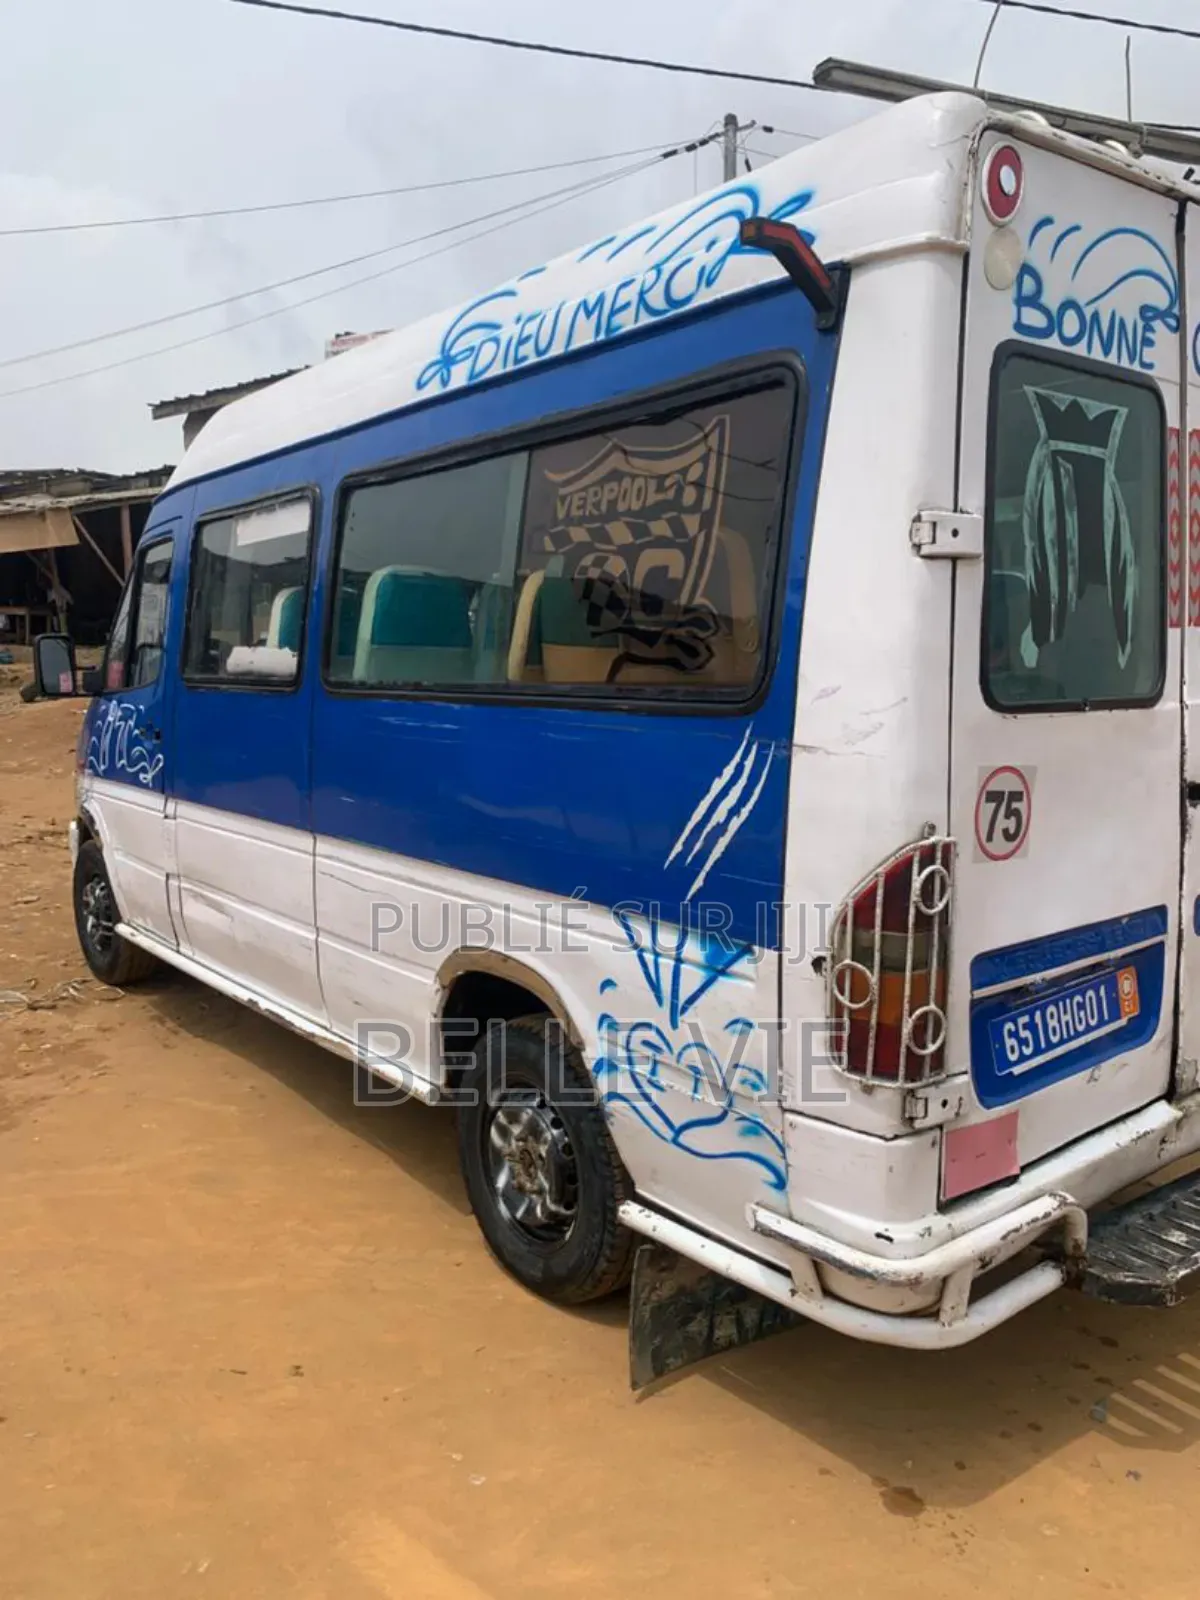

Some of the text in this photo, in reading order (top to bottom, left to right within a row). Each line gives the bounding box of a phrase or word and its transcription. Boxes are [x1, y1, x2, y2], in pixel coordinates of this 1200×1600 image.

[1013, 262, 1156, 370] BONNE
[984, 790, 1024, 843] 75
[1002, 985, 1110, 1062] 6518HG01
